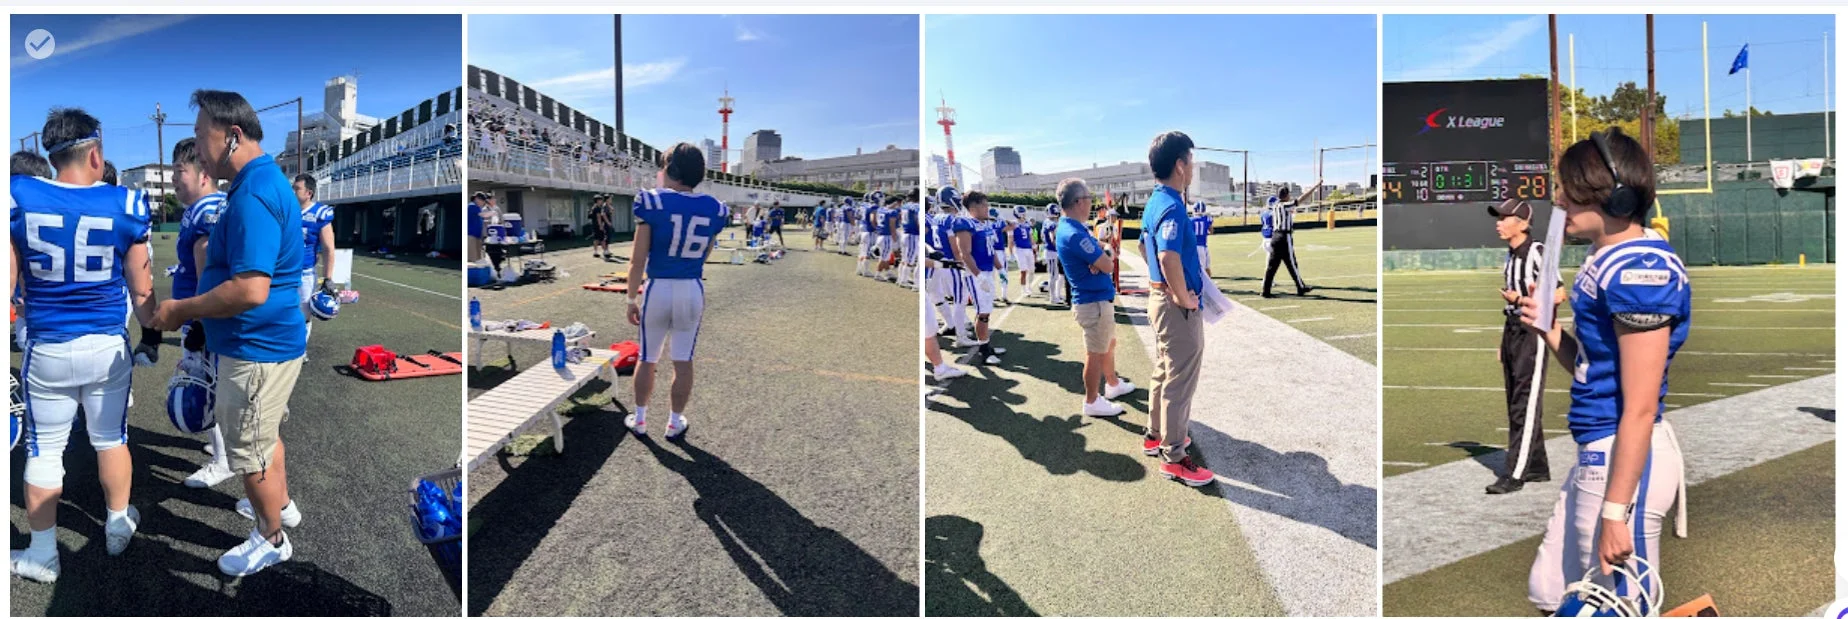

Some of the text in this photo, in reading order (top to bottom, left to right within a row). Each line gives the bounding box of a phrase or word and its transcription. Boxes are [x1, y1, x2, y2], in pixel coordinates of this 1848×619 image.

[1445, 116, 1504, 129] X League
[1492, 186, 1508, 199] 32
[1517, 175, 1545, 198] 28
[1416, 188, 1428, 201] 10
[668, 213, 711, 258] 16
[1194, 221, 1204, 236] 11
[25, 212, 114, 282] 56
